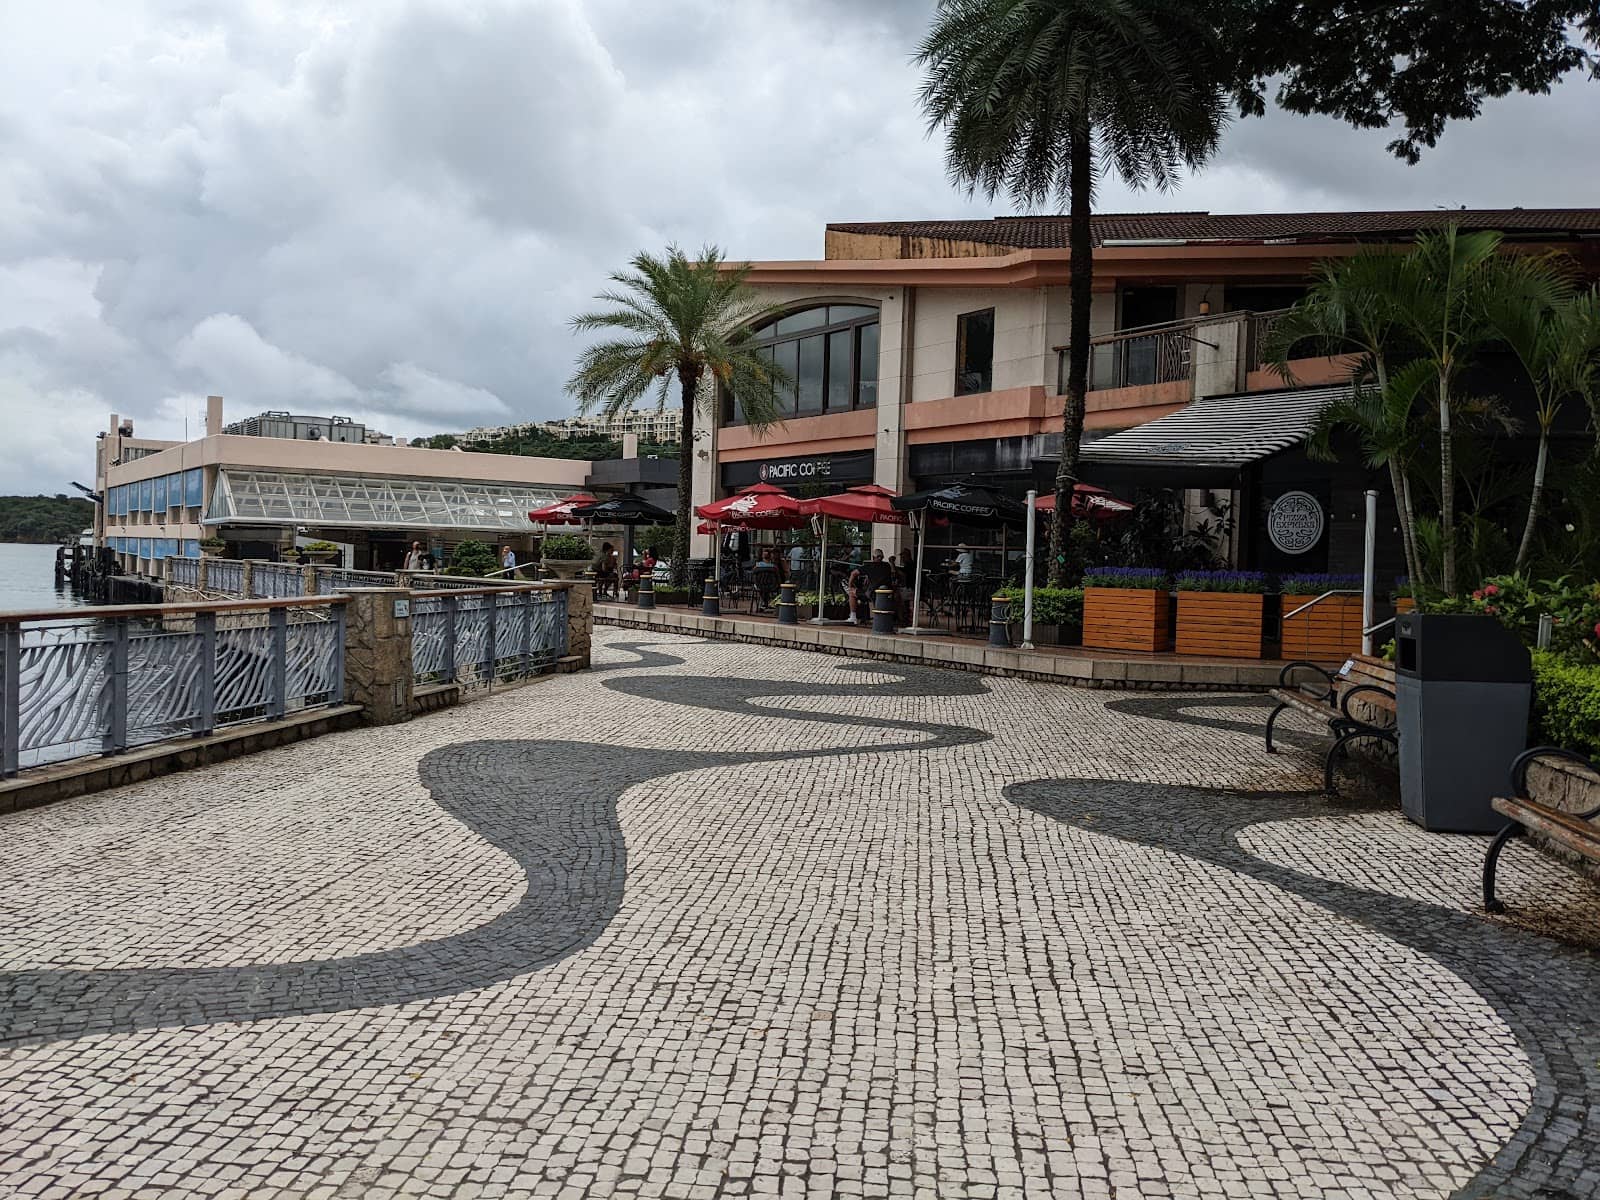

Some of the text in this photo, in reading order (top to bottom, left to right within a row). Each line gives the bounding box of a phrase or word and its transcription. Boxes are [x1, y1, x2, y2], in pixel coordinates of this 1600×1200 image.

[769, 463, 798, 478] PACIFIC
[933, 500, 989, 513] PACIFIC COFFEE
